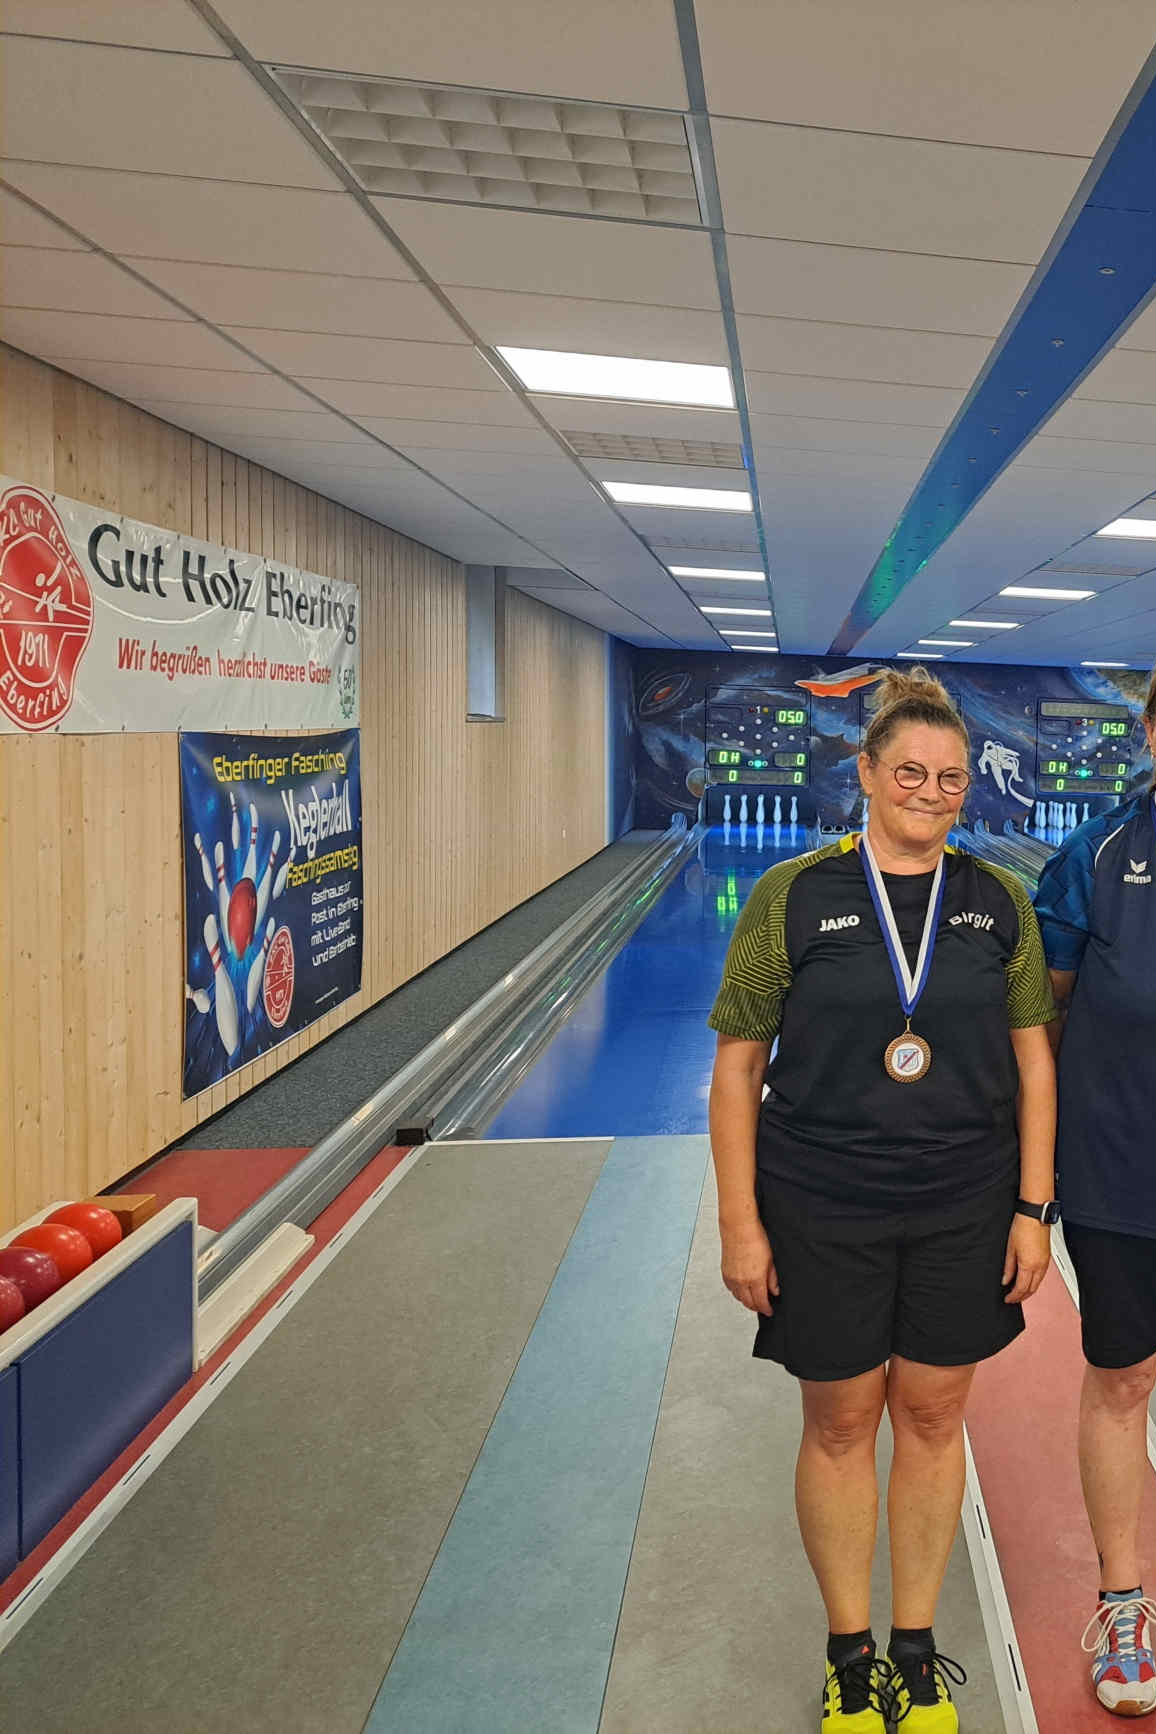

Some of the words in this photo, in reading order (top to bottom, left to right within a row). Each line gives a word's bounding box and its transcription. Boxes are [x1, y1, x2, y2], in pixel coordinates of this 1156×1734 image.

[88, 523, 167, 598] Gut
[181, 550, 256, 613] Holz
[265, 571, 356, 644] Eberfing
[18, 630, 50, 668] 1971
[118, 637, 146, 671] Wir
[150, 640, 212, 681] begrüßen
[217, 648, 268, 679] herzlichst
[270, 662, 305, 682] unsere
[309, 660, 332, 684] Gäste
[0, 670, 68, 718] Eberfing
[213, 753, 289, 784] Eberfinger
[291, 749, 347, 775] Fasching
[281, 779, 352, 860] Keglerball
[1123, 874, 1152, 885] erima
[819, 914, 860, 932] JAKO
[948, 911, 994, 931] Birgit
